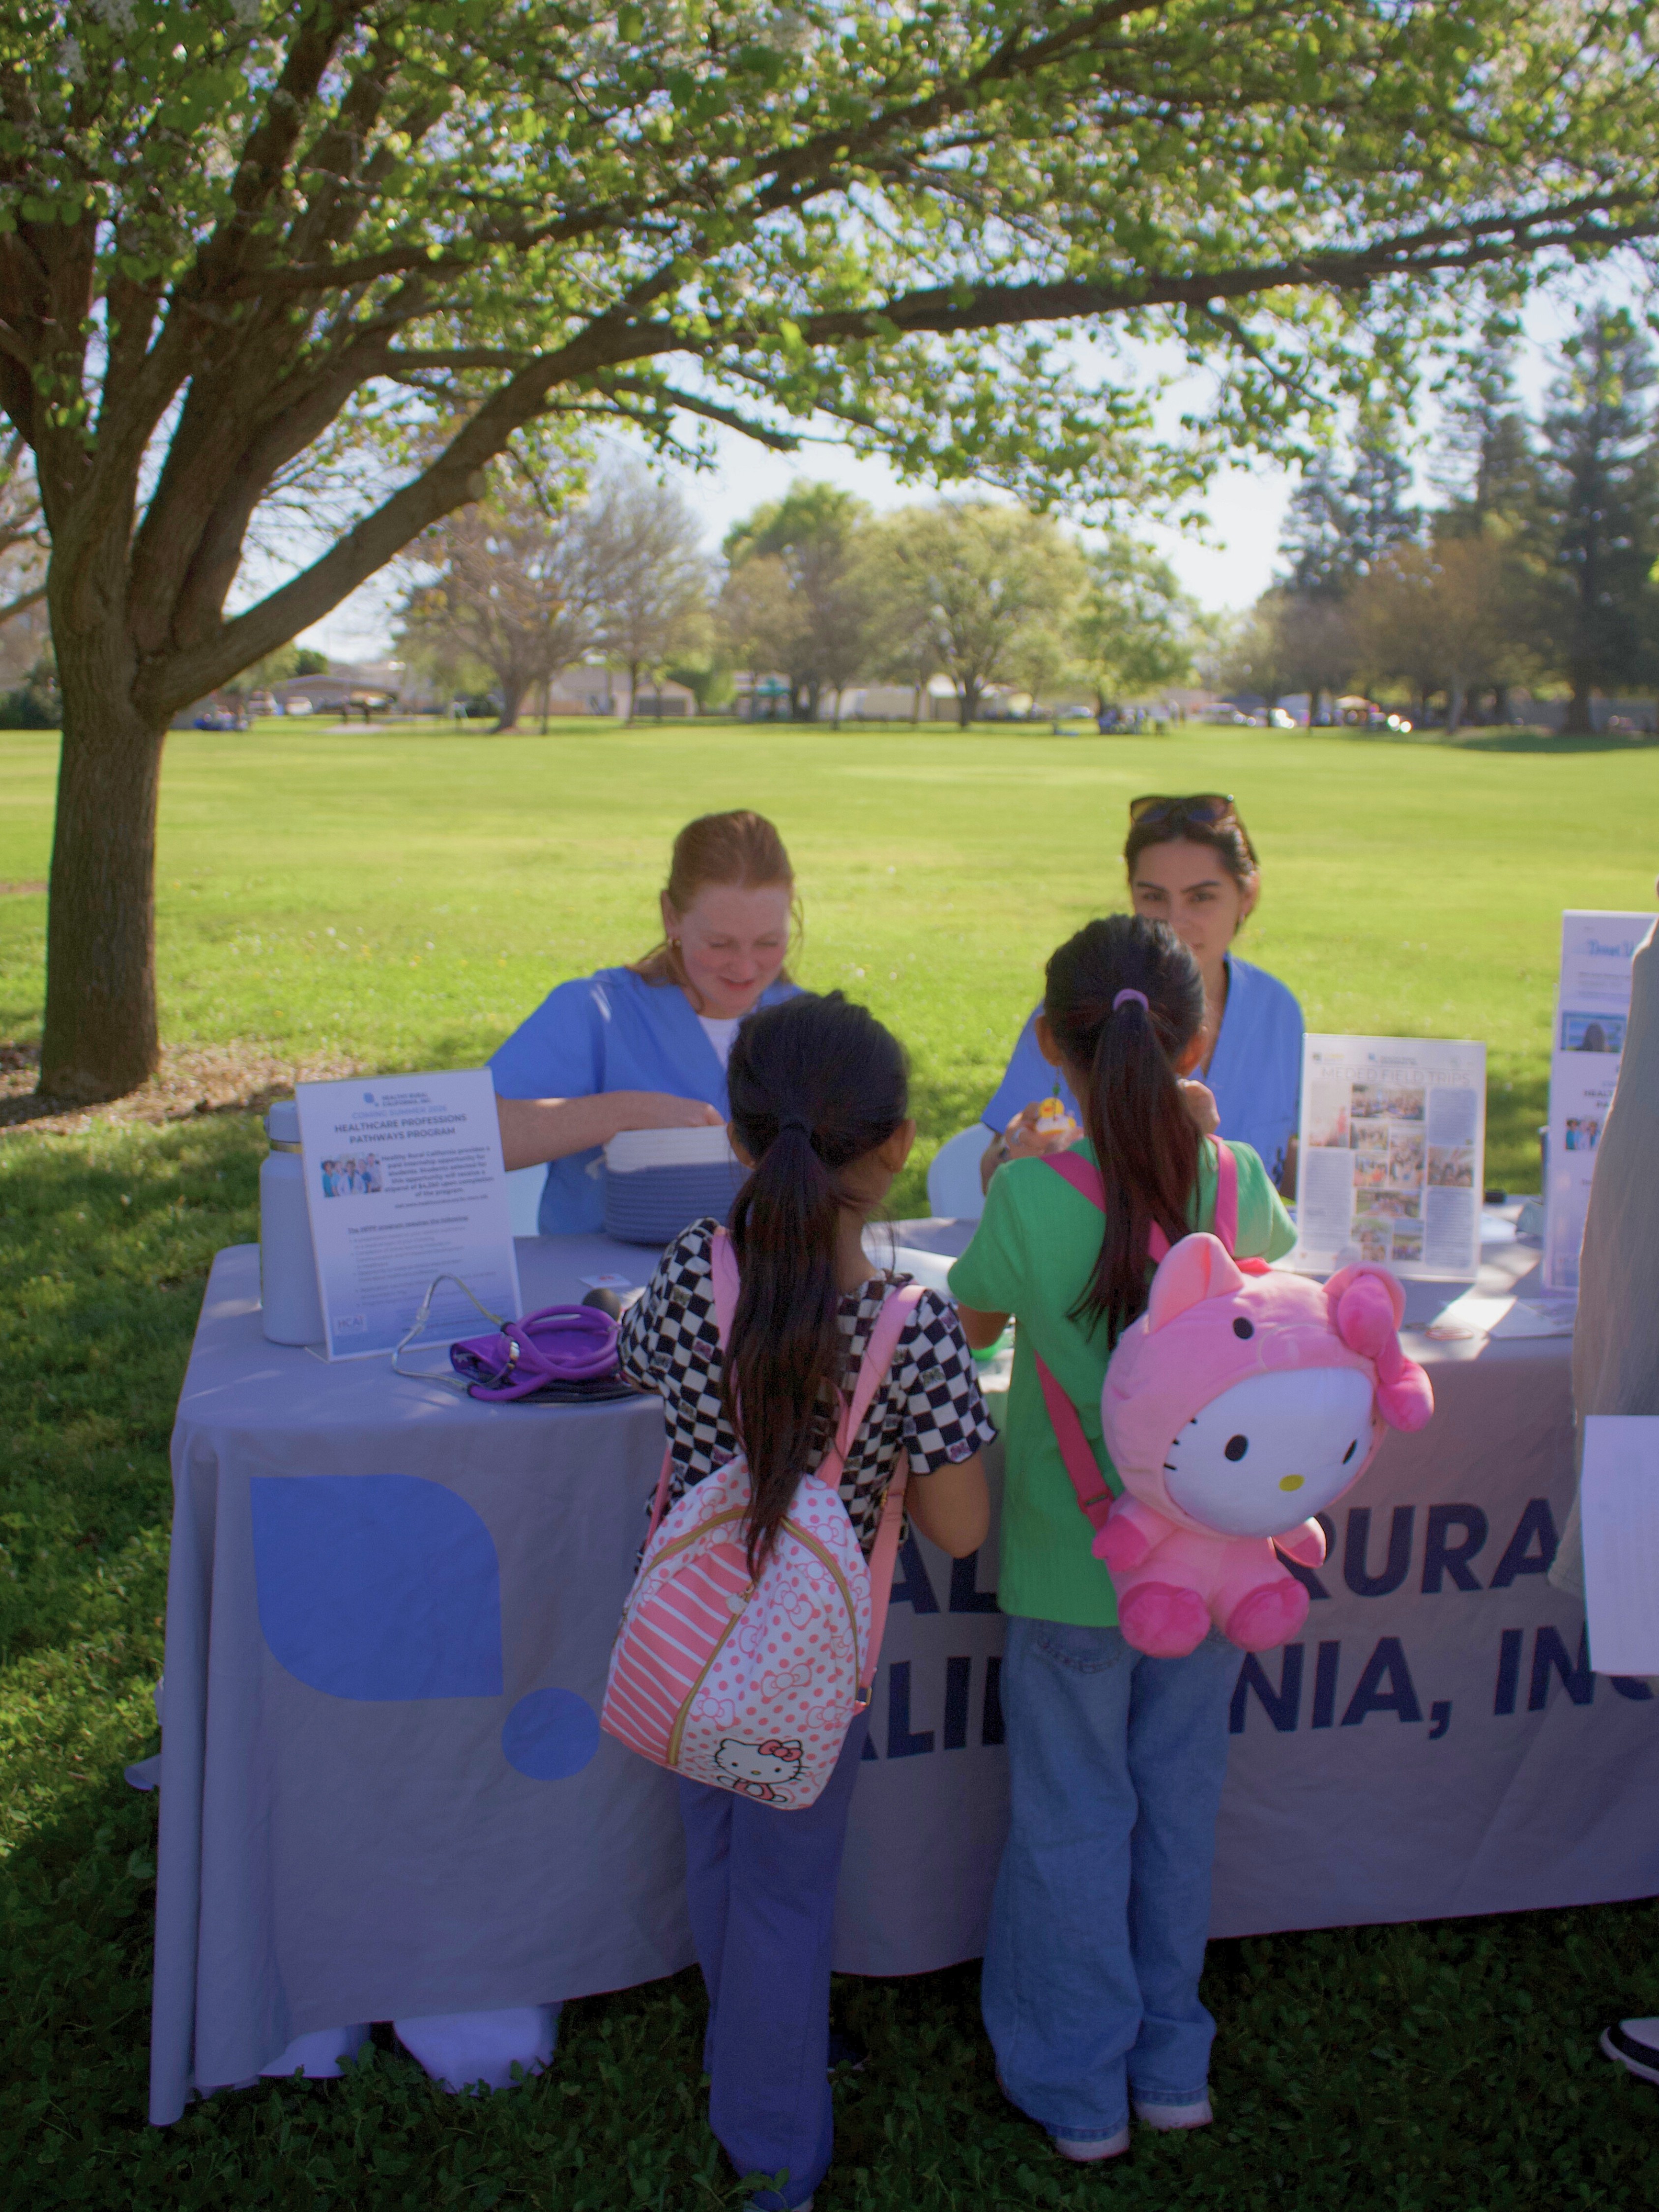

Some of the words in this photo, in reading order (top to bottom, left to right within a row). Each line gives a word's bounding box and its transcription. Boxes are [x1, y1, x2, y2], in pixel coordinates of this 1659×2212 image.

[335, 1119, 399, 1132] HEALTHCARE
[402, 1113, 466, 1126] PROFESSIONS
[349, 1131, 406, 1144] PATHWAYS
[407, 1127, 455, 1138] PROGRAM
